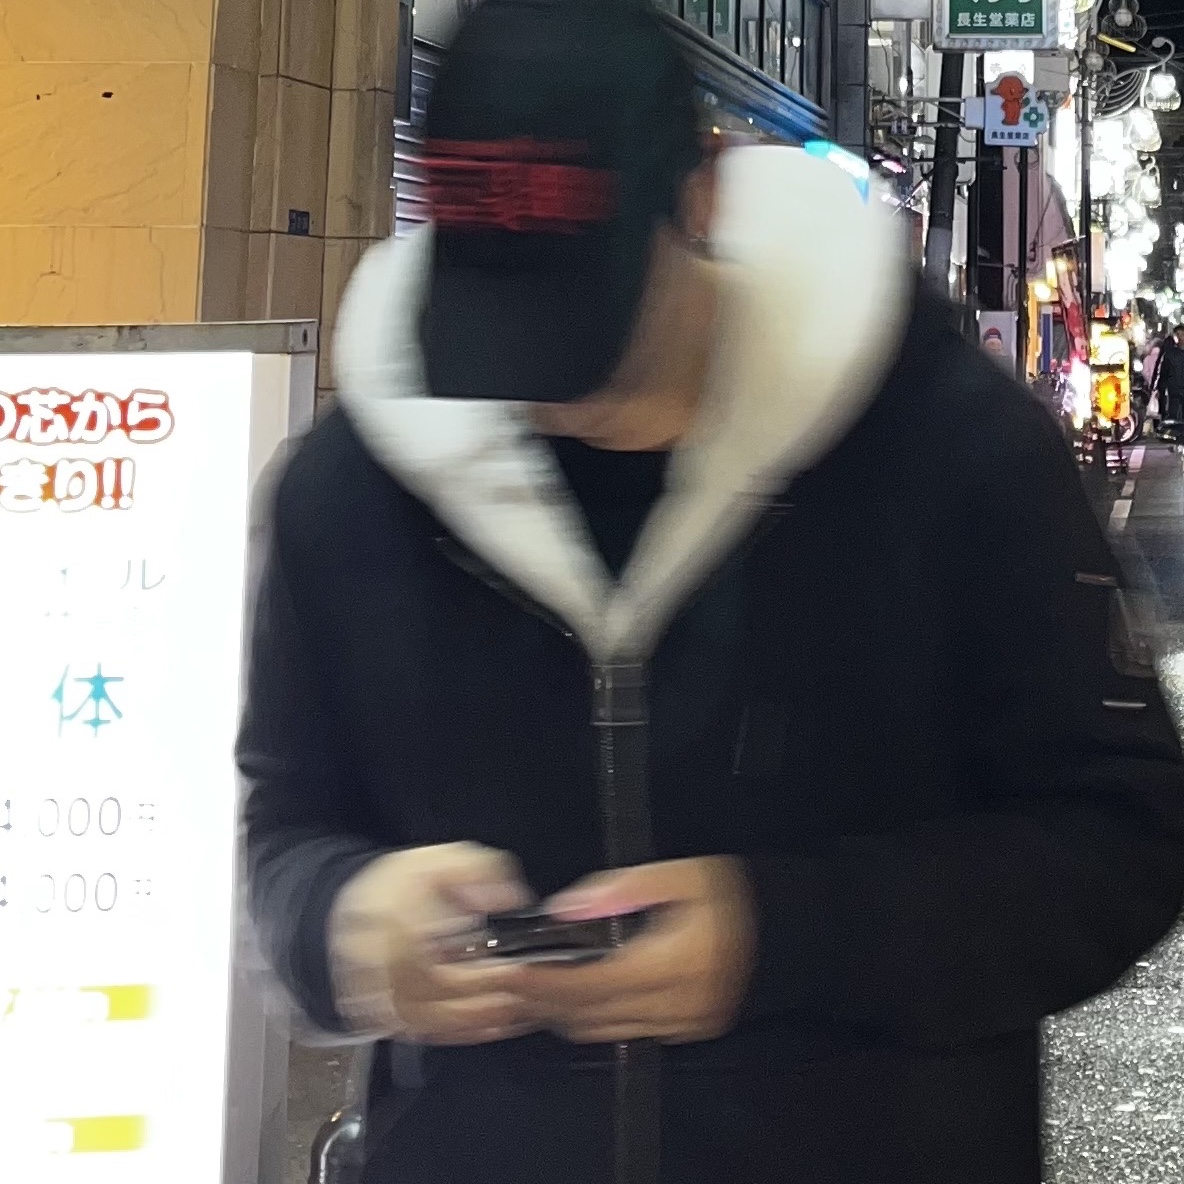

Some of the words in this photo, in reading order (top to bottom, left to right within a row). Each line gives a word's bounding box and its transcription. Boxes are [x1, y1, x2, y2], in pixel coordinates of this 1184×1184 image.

[956, 12, 1036, 27] 長生堂薬店
